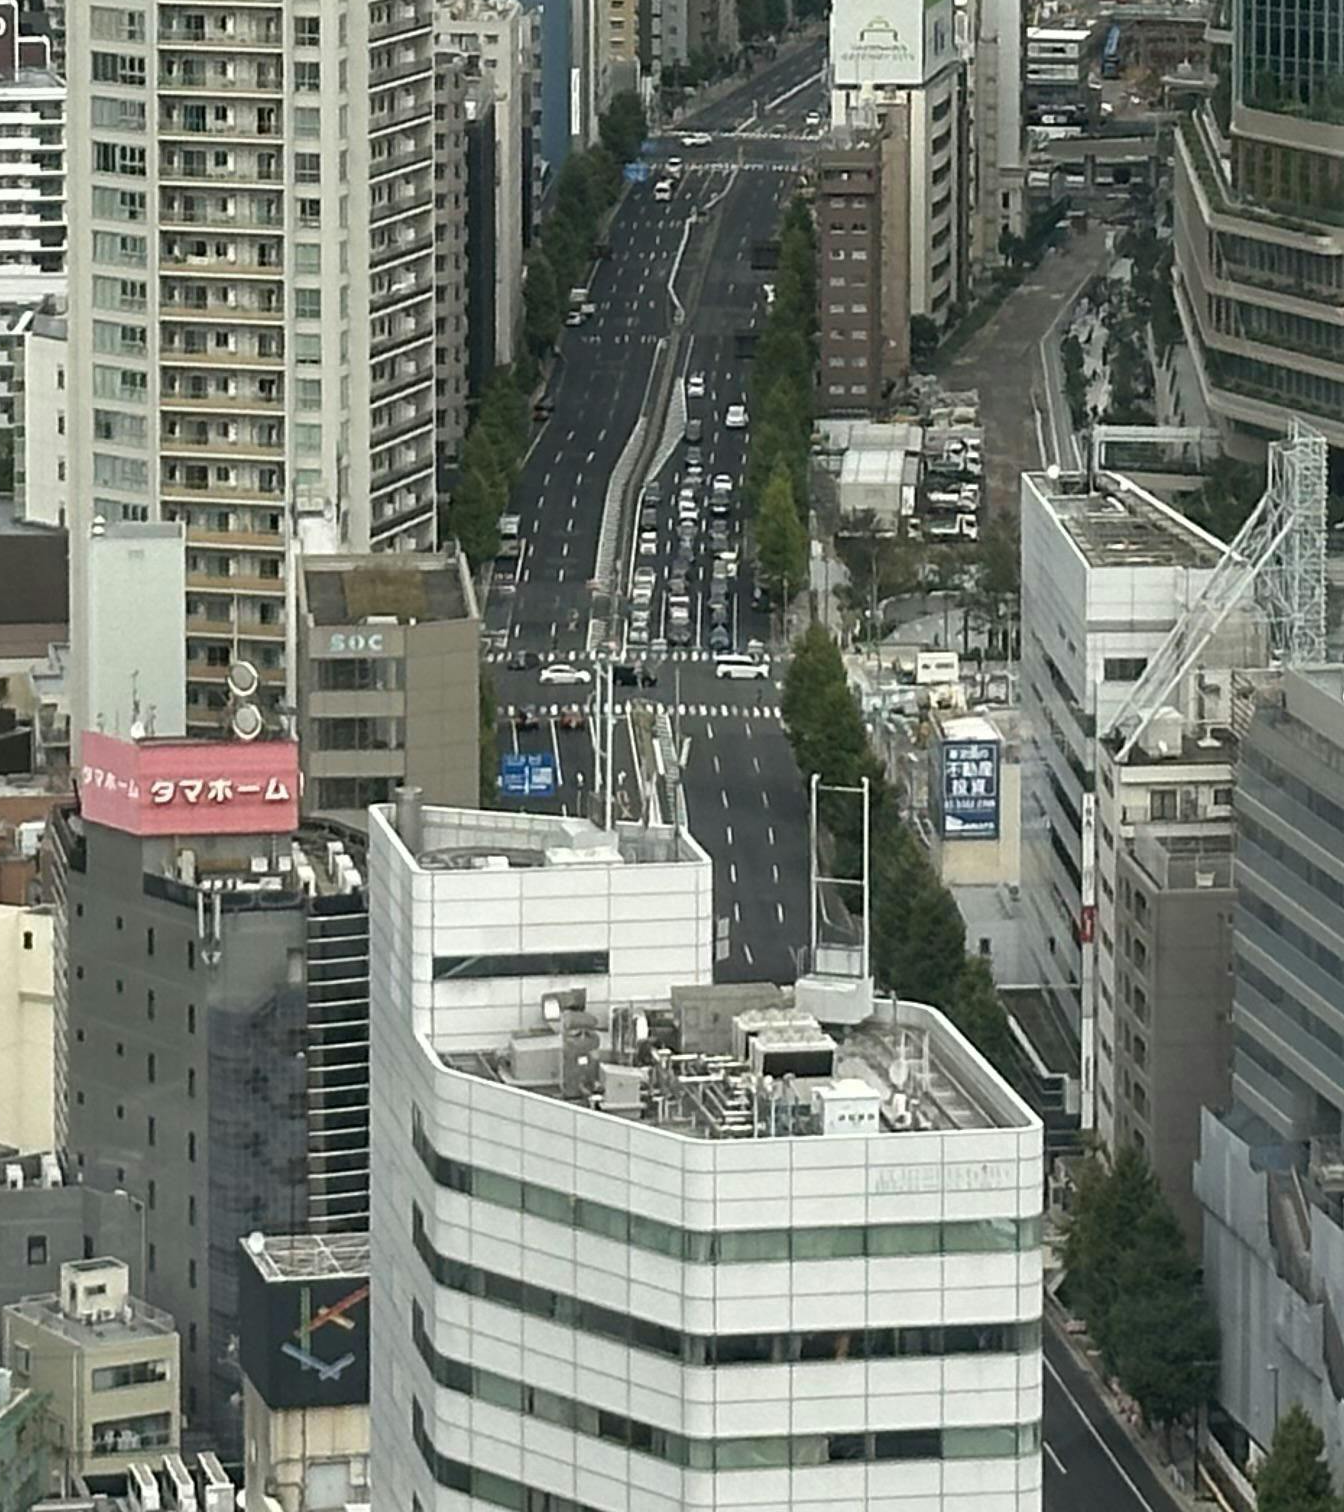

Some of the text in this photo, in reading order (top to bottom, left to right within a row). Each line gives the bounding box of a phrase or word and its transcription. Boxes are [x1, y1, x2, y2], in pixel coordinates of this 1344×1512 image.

[329, 632, 384, 652] SOC
[81, 765, 139, 799] タマホーム
[151, 777, 290, 803] タマホーム
